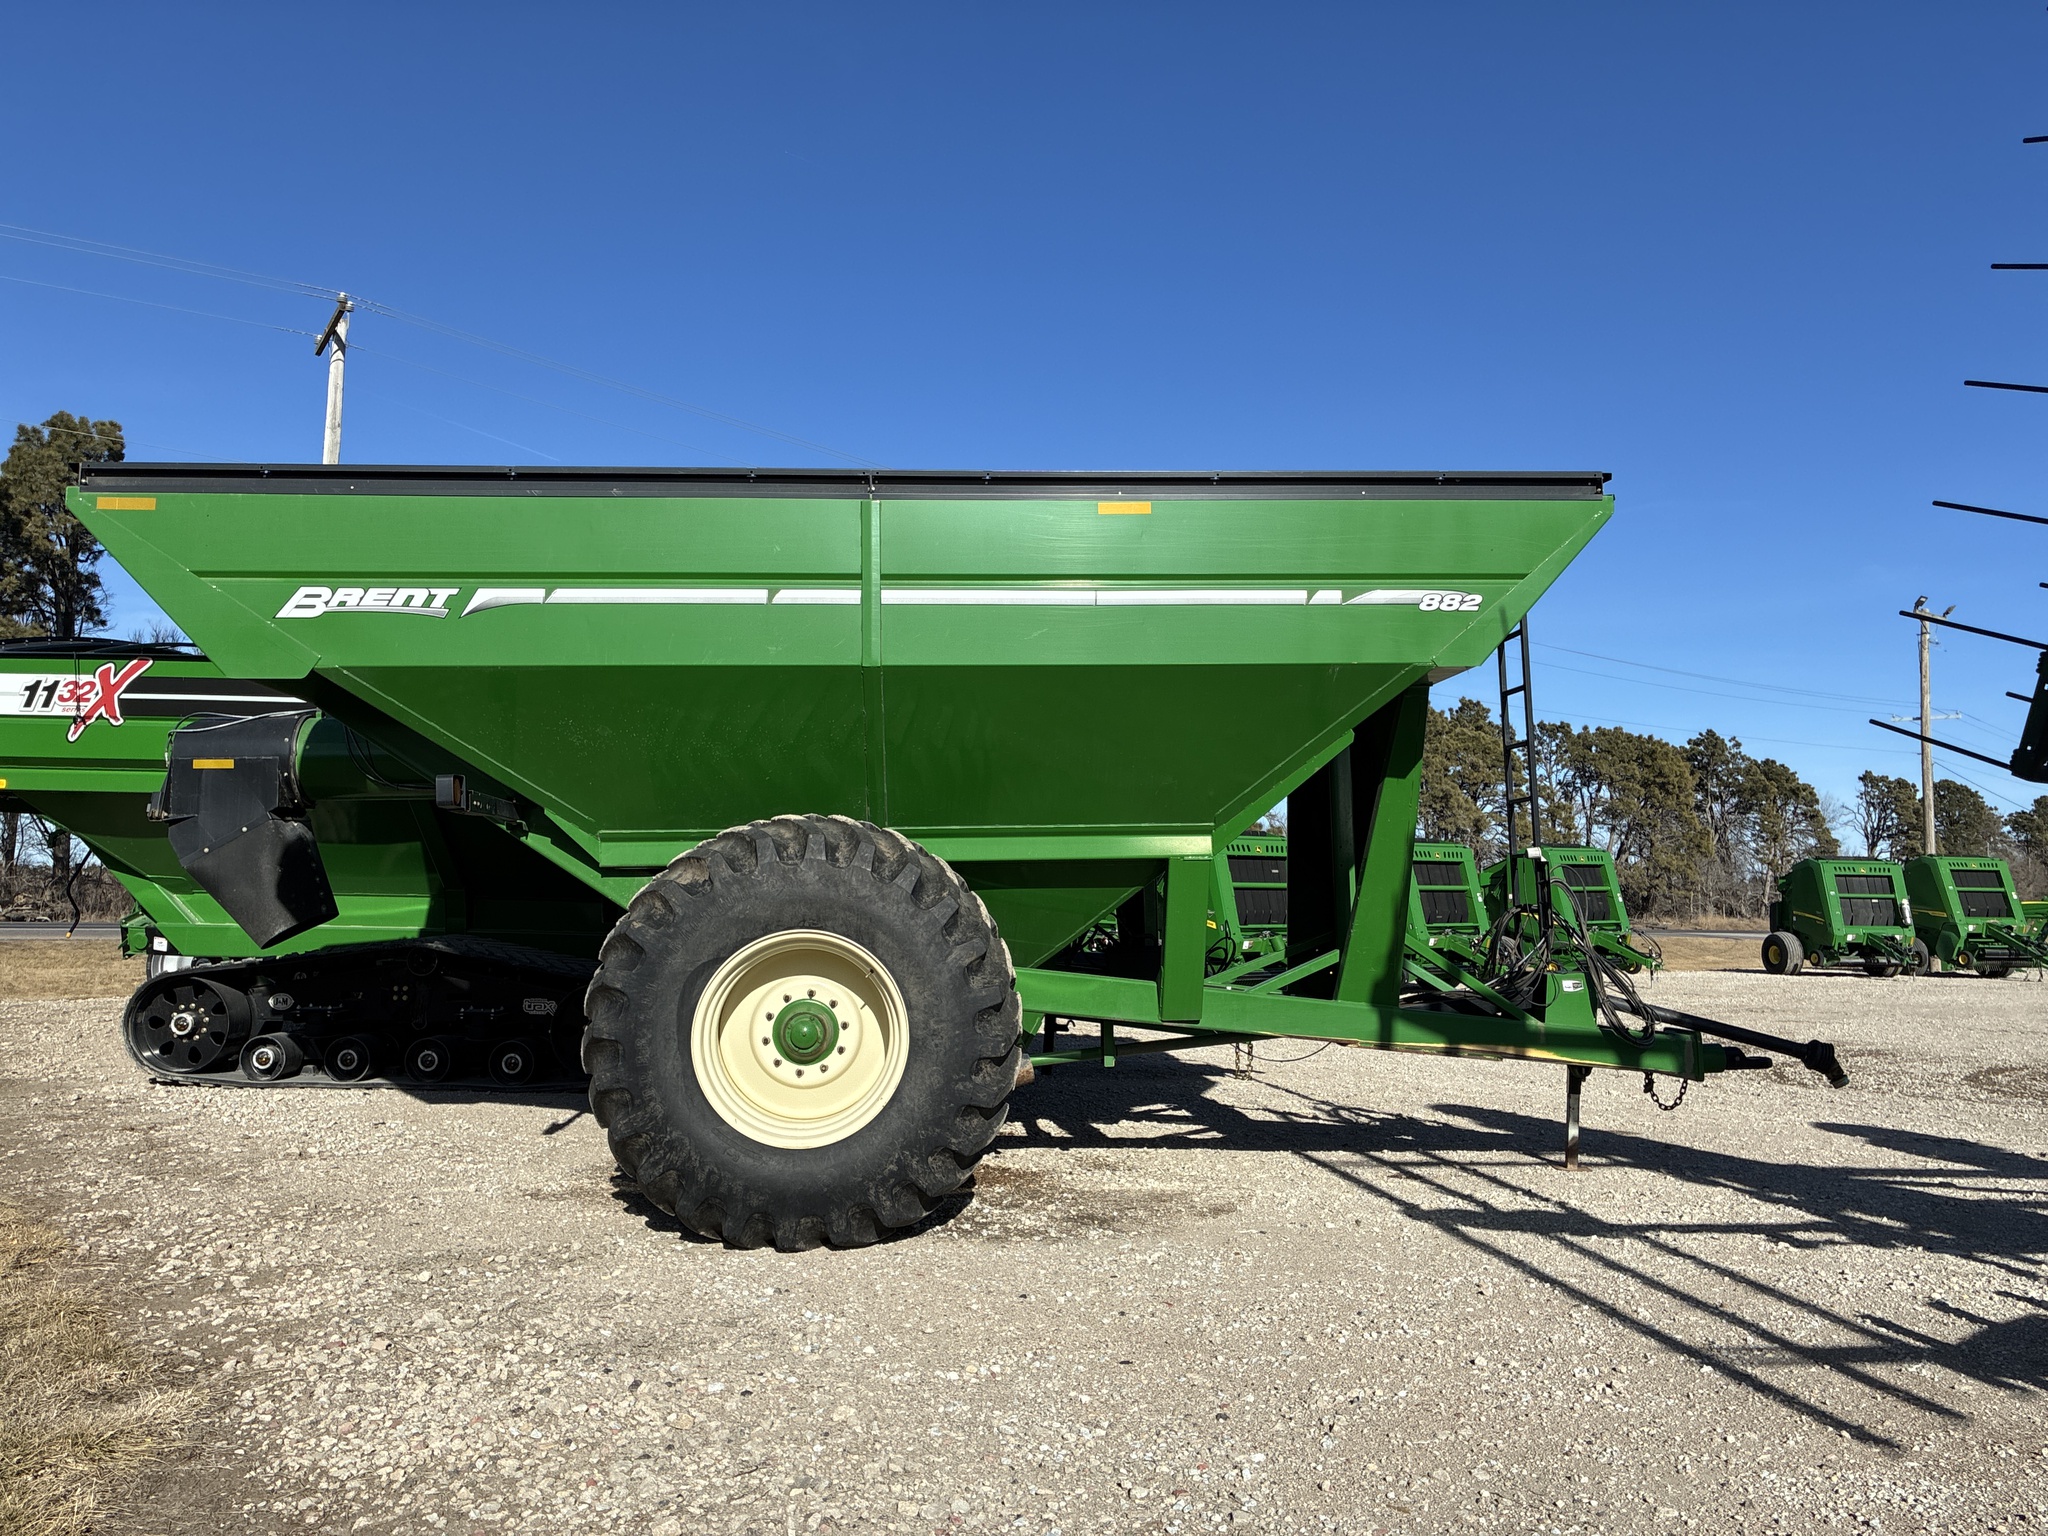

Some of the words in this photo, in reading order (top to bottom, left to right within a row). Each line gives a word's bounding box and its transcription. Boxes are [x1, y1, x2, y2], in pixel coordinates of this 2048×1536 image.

[274, 587, 461, 618] BRENT
[1419, 593, 1483, 612] 882
[61, 706, 86, 714] seris
